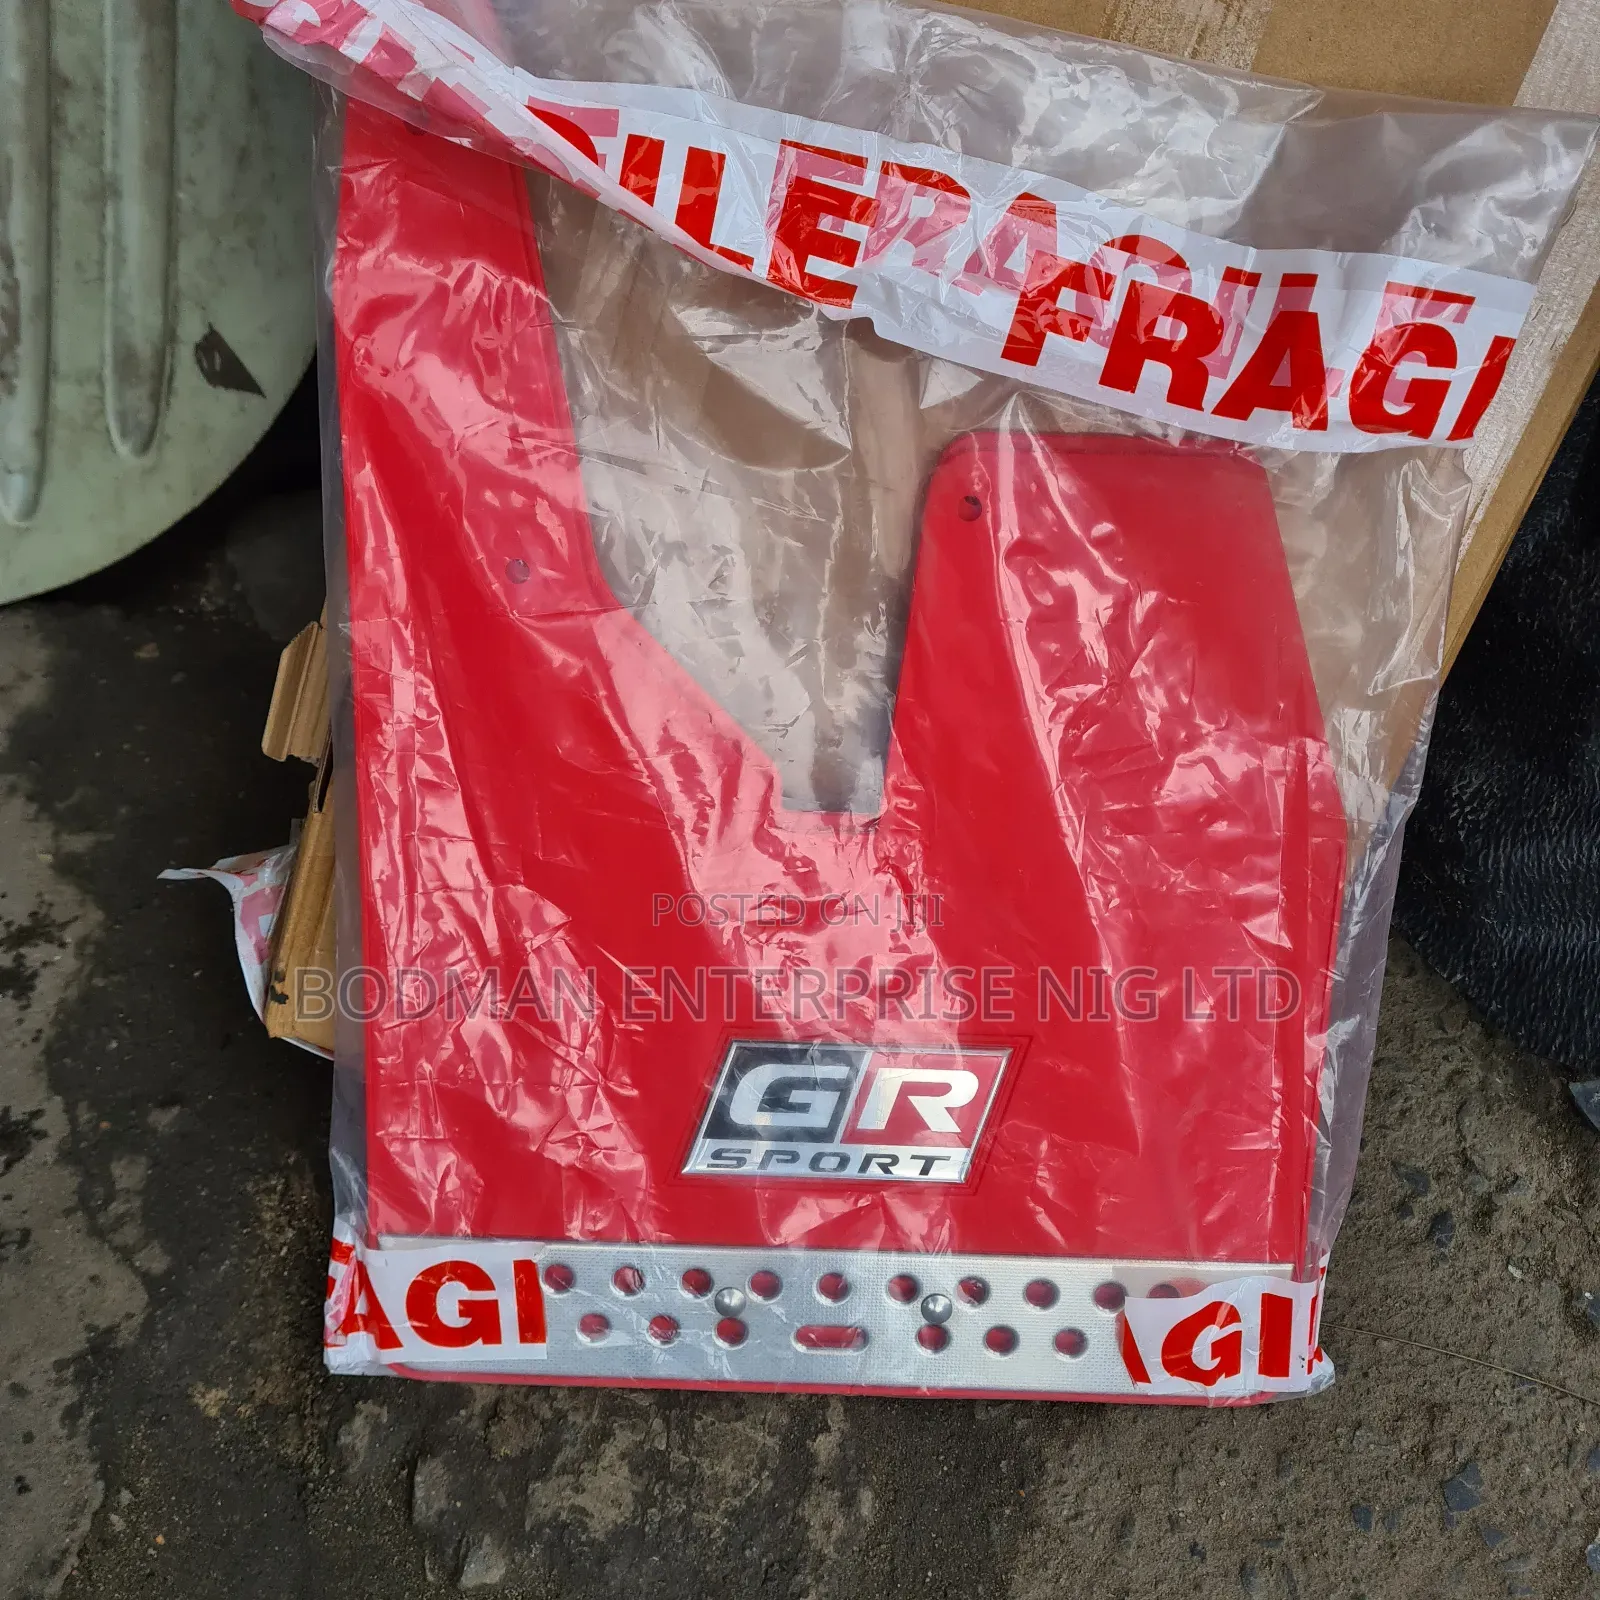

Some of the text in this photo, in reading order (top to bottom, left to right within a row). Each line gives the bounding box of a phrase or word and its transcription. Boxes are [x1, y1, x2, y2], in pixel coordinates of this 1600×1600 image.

[729, 1063, 979, 1133] GR
[706, 1147, 952, 1176] SPORT
[326, 1238, 547, 1350] AGI
